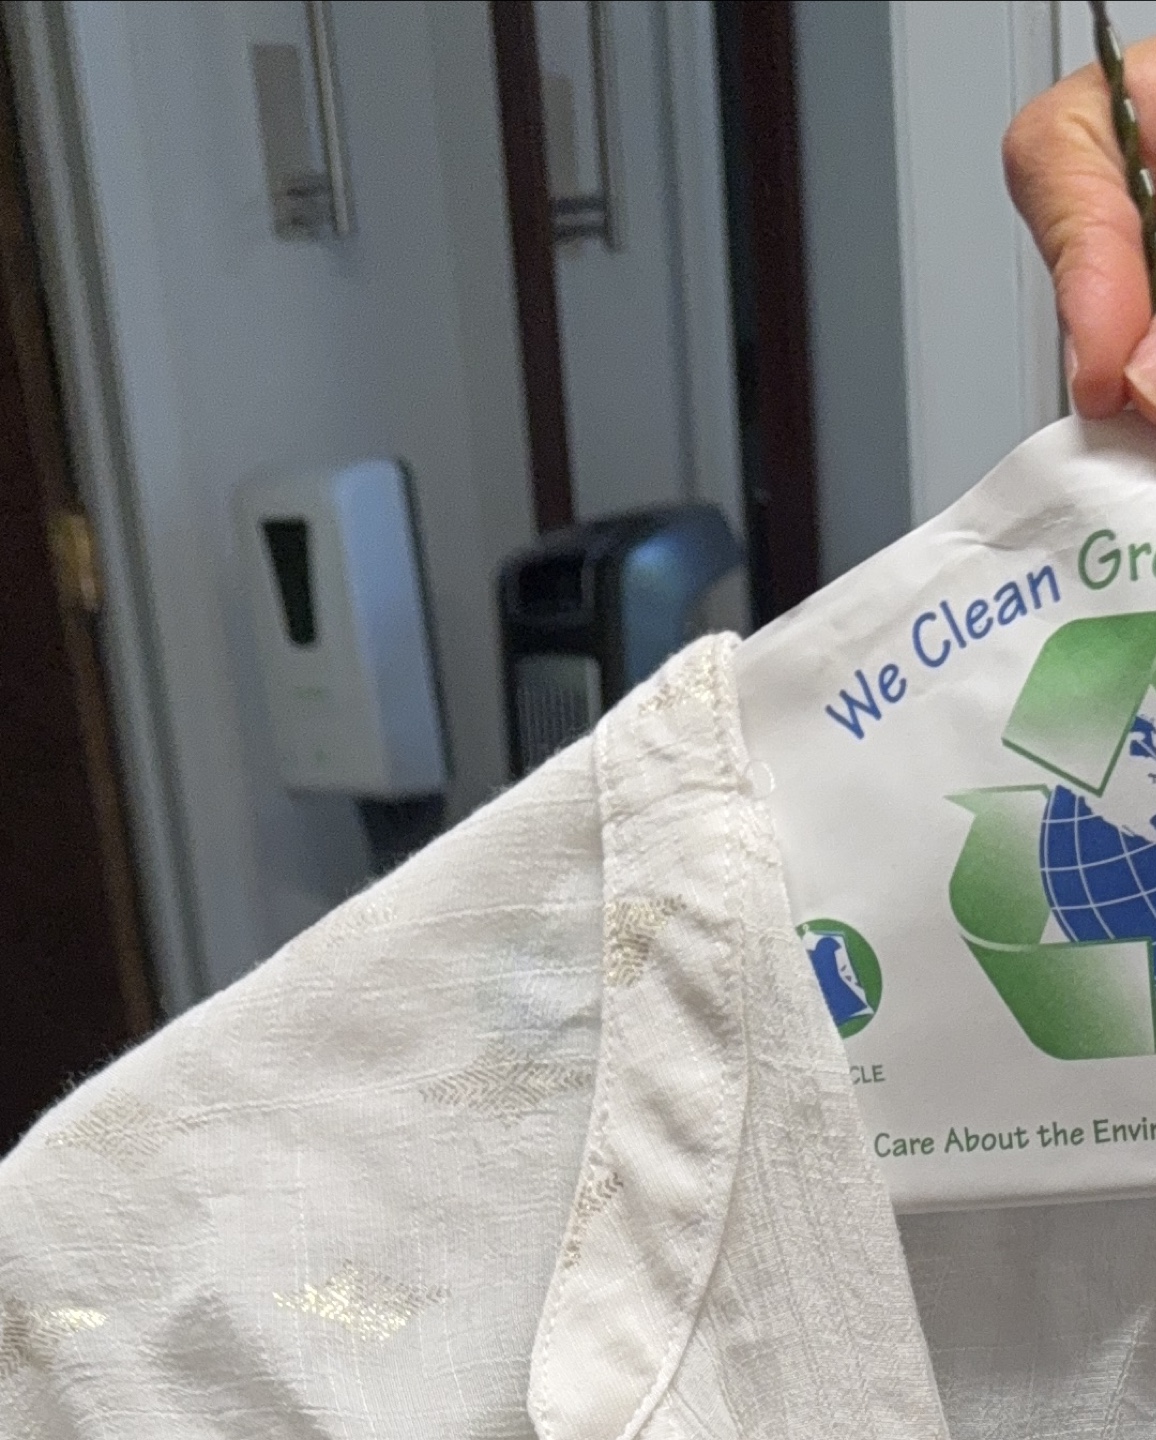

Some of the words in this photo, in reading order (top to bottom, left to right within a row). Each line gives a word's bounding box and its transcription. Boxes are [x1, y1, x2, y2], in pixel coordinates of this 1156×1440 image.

[825, 663, 907, 740] We
[911, 565, 1061, 668] Clean
[873, 1133, 935, 1158] Care
[944, 1126, 1030, 1153] About
[1036, 1121, 1085, 1147] the
